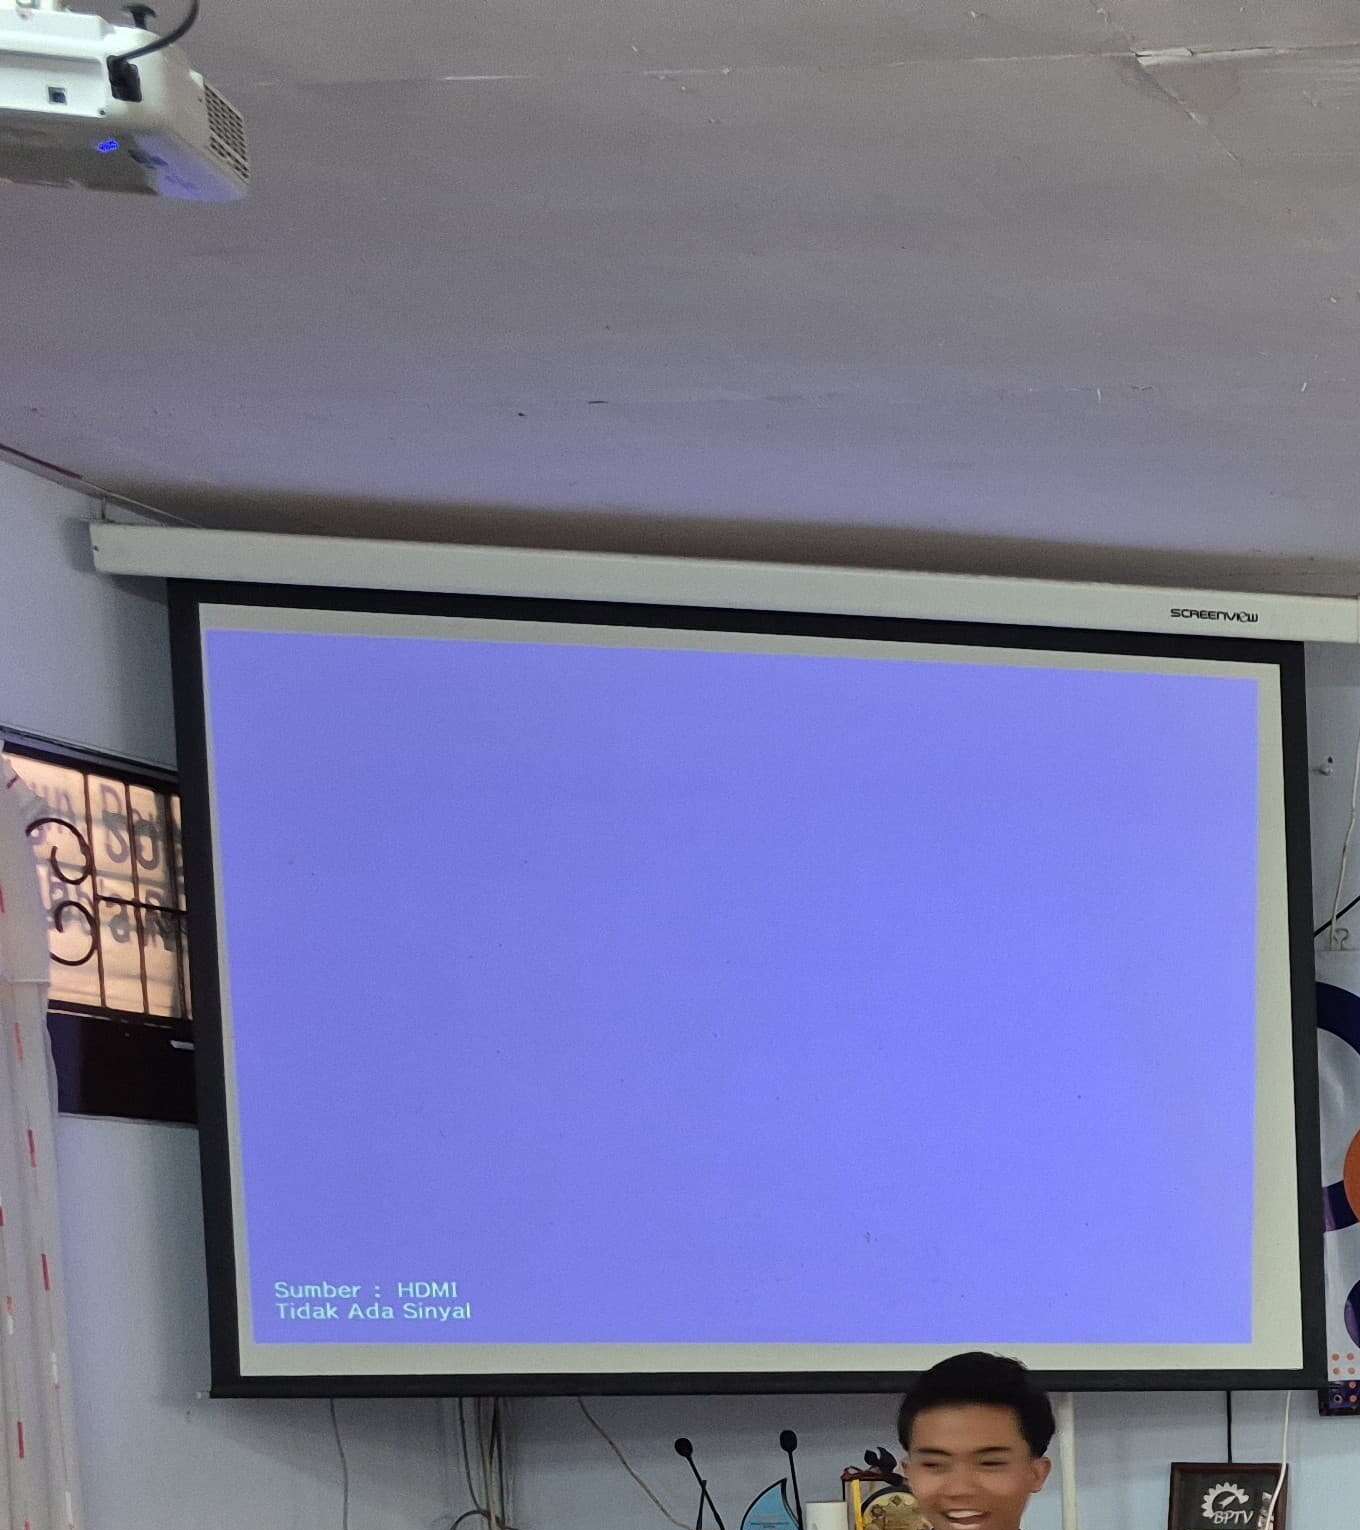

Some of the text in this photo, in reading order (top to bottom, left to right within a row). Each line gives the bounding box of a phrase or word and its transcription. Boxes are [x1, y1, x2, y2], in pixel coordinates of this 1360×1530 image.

[274, 1281, 361, 1298] Sumber
[398, 1282, 458, 1298] HDMI
[276, 1303, 472, 1321] Tidak Ada Sinyal
[1213, 1510, 1254, 1525] BPTV
